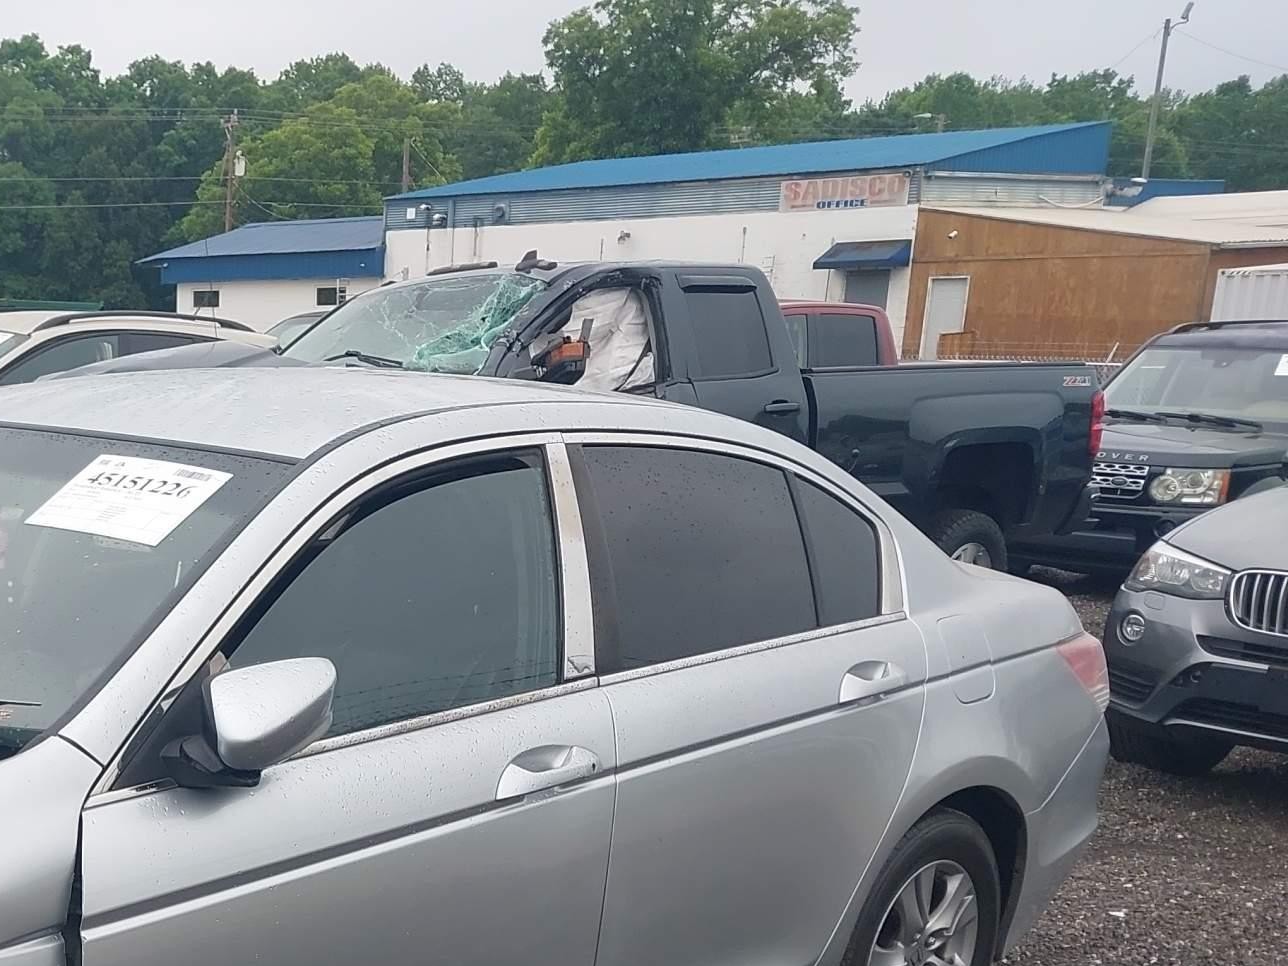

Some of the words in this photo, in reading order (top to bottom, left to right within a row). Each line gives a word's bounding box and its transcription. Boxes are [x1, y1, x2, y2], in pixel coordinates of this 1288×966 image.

[785, 174, 906, 201] SADISCO
[816, 199, 865, 209] OFFICE
[1096, 451, 1149, 461] OVER
[87, 471, 199, 499] 45151226
